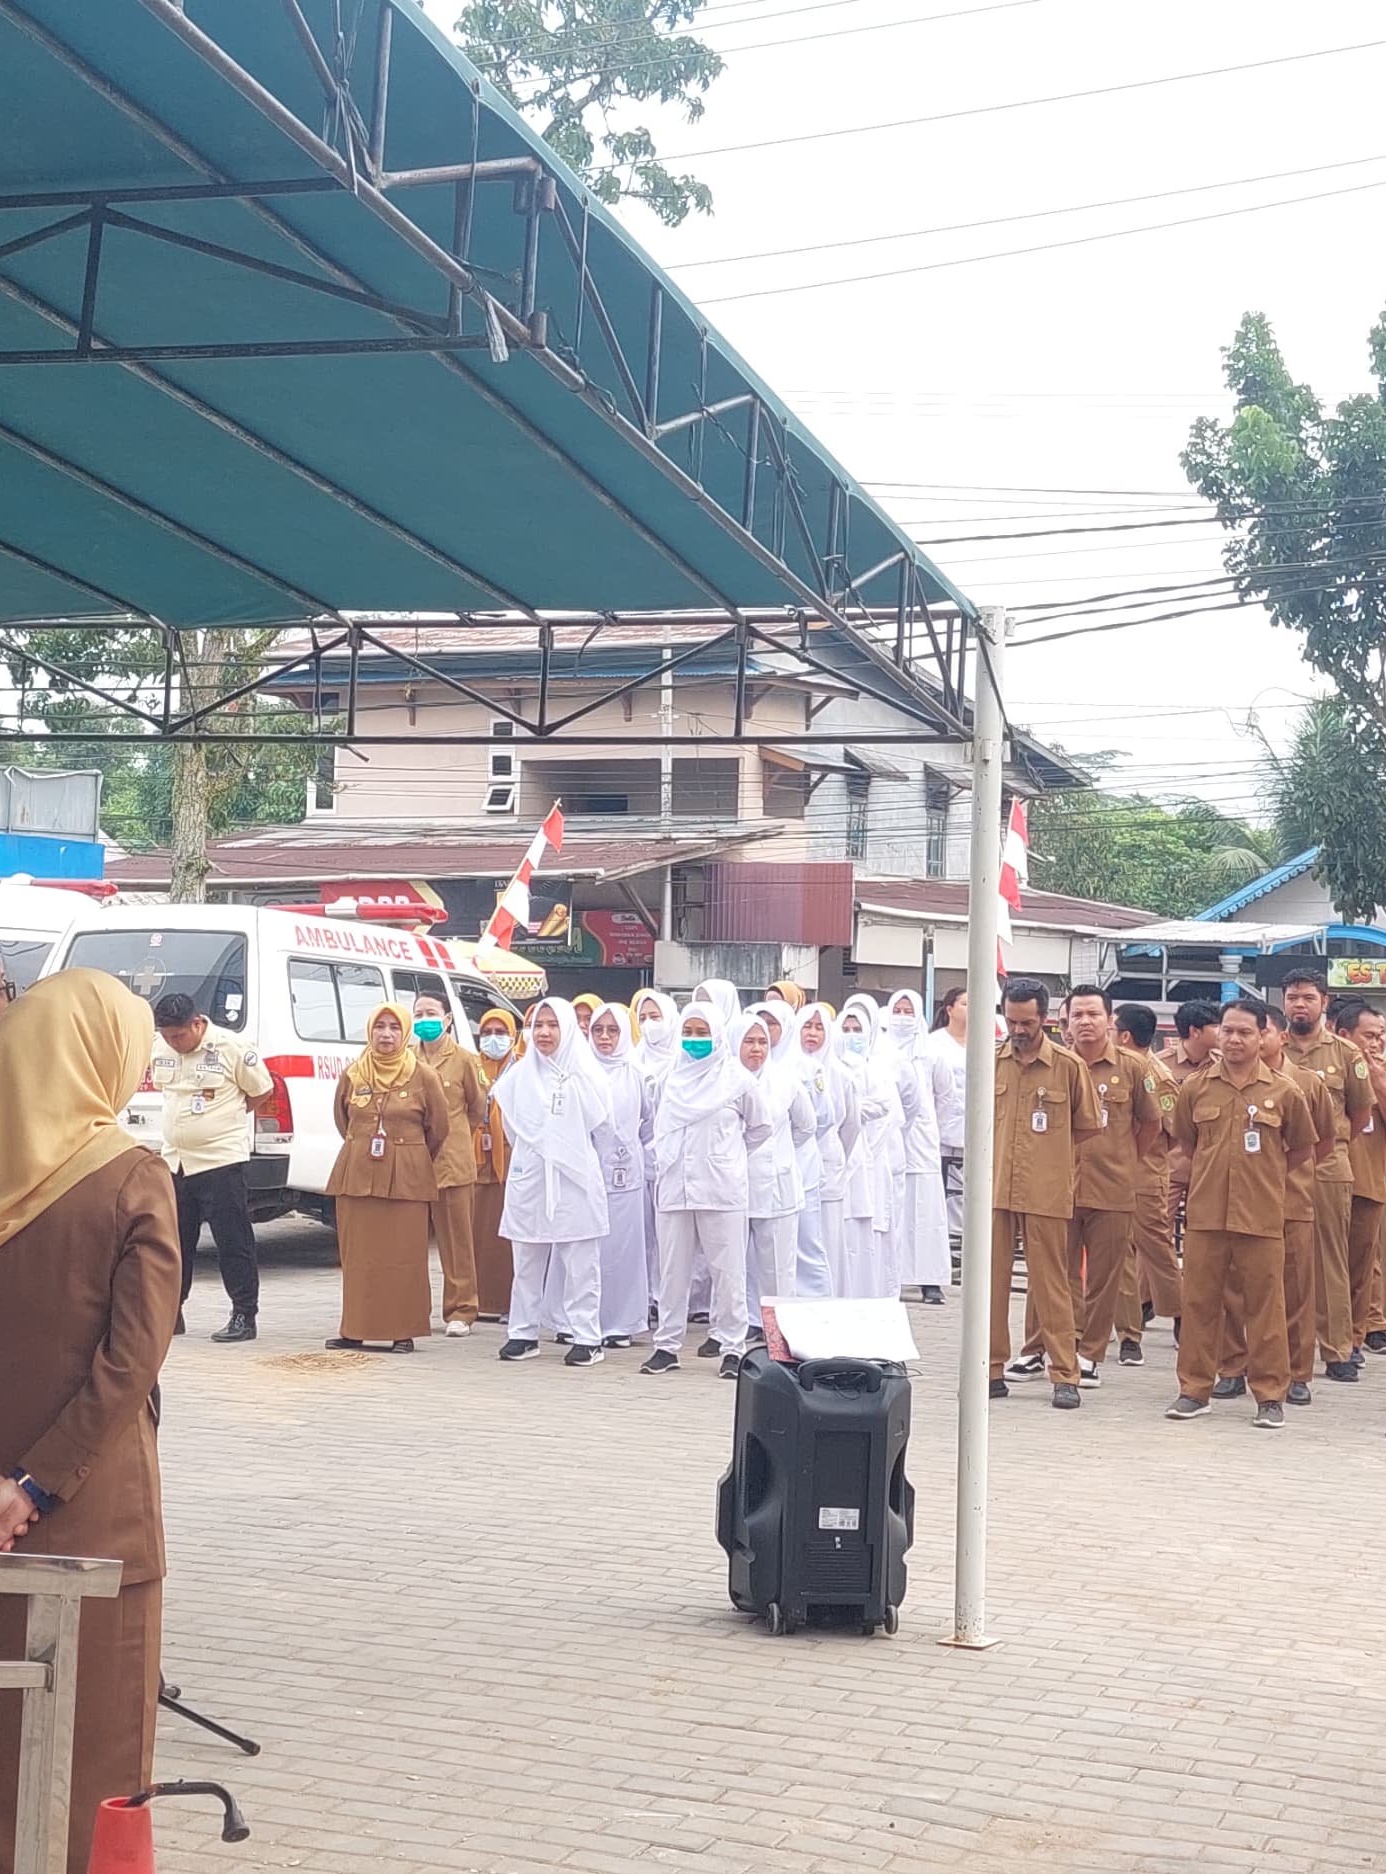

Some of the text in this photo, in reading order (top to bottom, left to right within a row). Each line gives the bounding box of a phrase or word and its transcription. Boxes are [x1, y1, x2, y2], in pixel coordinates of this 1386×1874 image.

[295, 925, 413, 961] AMBULANCE
[1347, 963, 1373, 984] ES
[318, 1056, 342, 1080] RSUD
